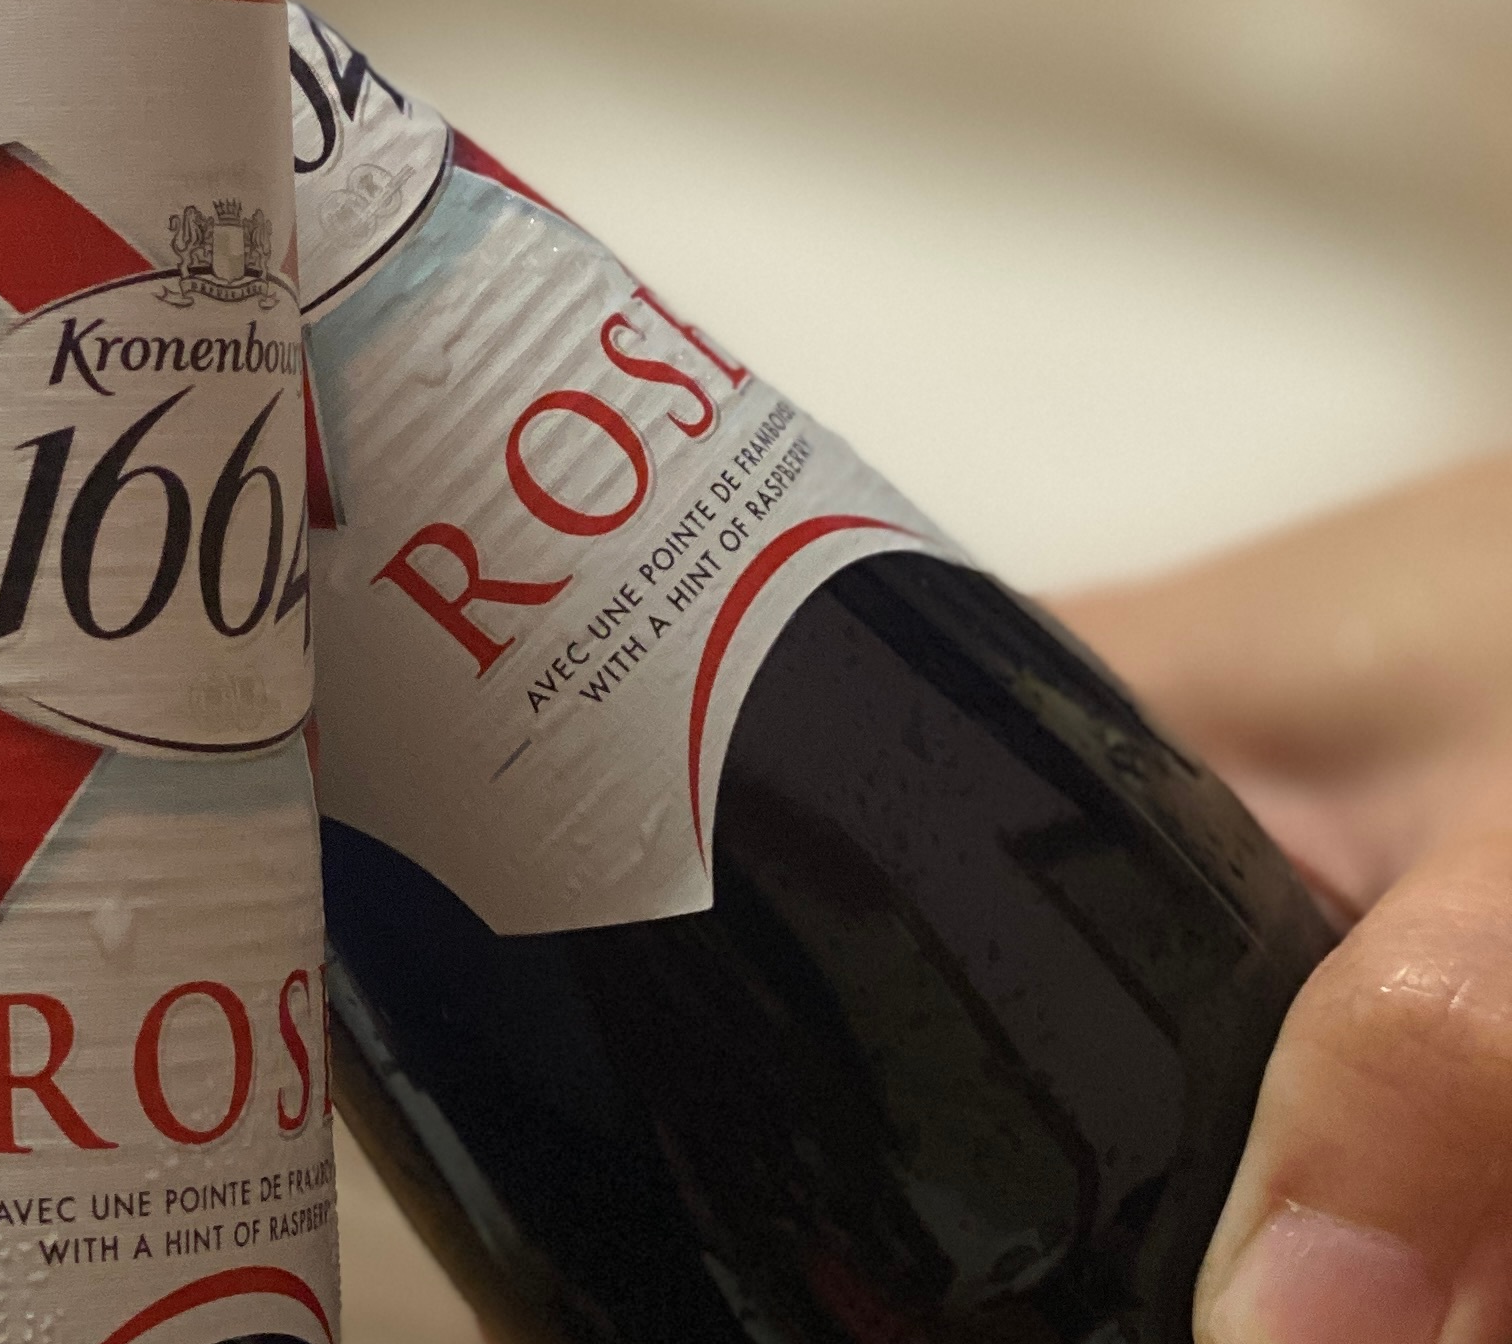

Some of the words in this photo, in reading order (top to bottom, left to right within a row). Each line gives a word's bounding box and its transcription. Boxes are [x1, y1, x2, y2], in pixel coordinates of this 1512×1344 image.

[525, 640, 590, 715] AVEC
[588, 583, 643, 641] UNE
[639, 499, 716, 587] POINTE
[710, 469, 742, 504] DE
[579, 634, 648, 704] WITH
[648, 615, 673, 642] A
[666, 553, 720, 613] HINT
[719, 516, 752, 552] OF
[38, 1236, 119, 1266] WITH
[132, 1233, 154, 1260] A
[165, 1223, 225, 1256] HINT
[234, 1219, 261, 1247] OF
[91, 1190, 152, 1221] UNE
[165, 1179, 251, 1213] POINTE
[260, 1174, 283, 1203] DE
